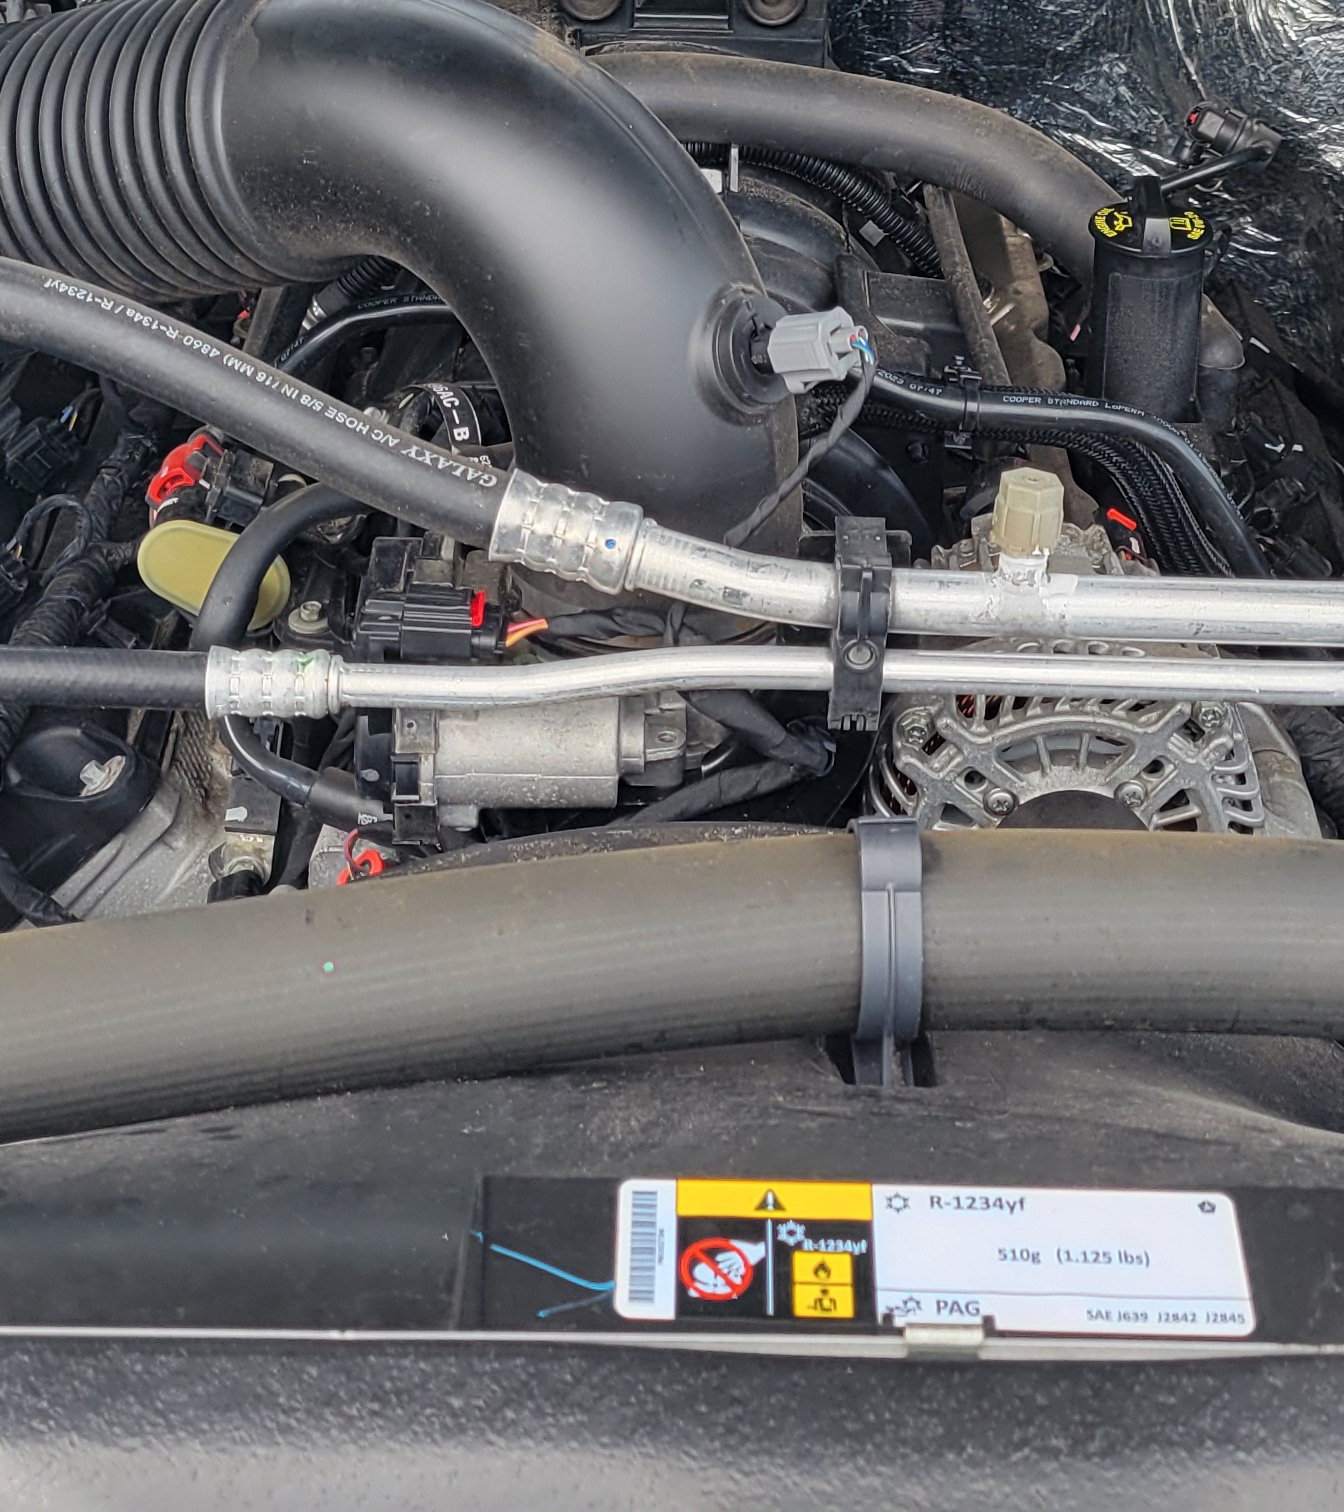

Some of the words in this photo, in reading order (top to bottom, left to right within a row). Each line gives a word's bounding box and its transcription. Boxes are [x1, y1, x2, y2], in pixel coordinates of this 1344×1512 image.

[125, 306, 180, 338] R-134a
[182, 333, 221, 359] 4860
[221, 353, 255, 378] MM)
[280, 382, 299, 400] IN
[1002, 394, 1042, 405] COOPER
[300, 392, 324, 413] 5/8
[326, 405, 369, 435] HOSE
[370, 427, 401, 449] A/C
[400, 444, 498, 487] GALAXY
[929, 1194, 1026, 1215] R-1234yf
[997, 1247, 1041, 1264] 510g
[1056, 1247, 1114, 1265] (1.125
[1118, 1248, 1151, 1268] lbs)
[936, 1299, 981, 1317] PAG
[1086, 1309, 1112, 1322] SAE
[1117, 1310, 1149, 1324] J639
